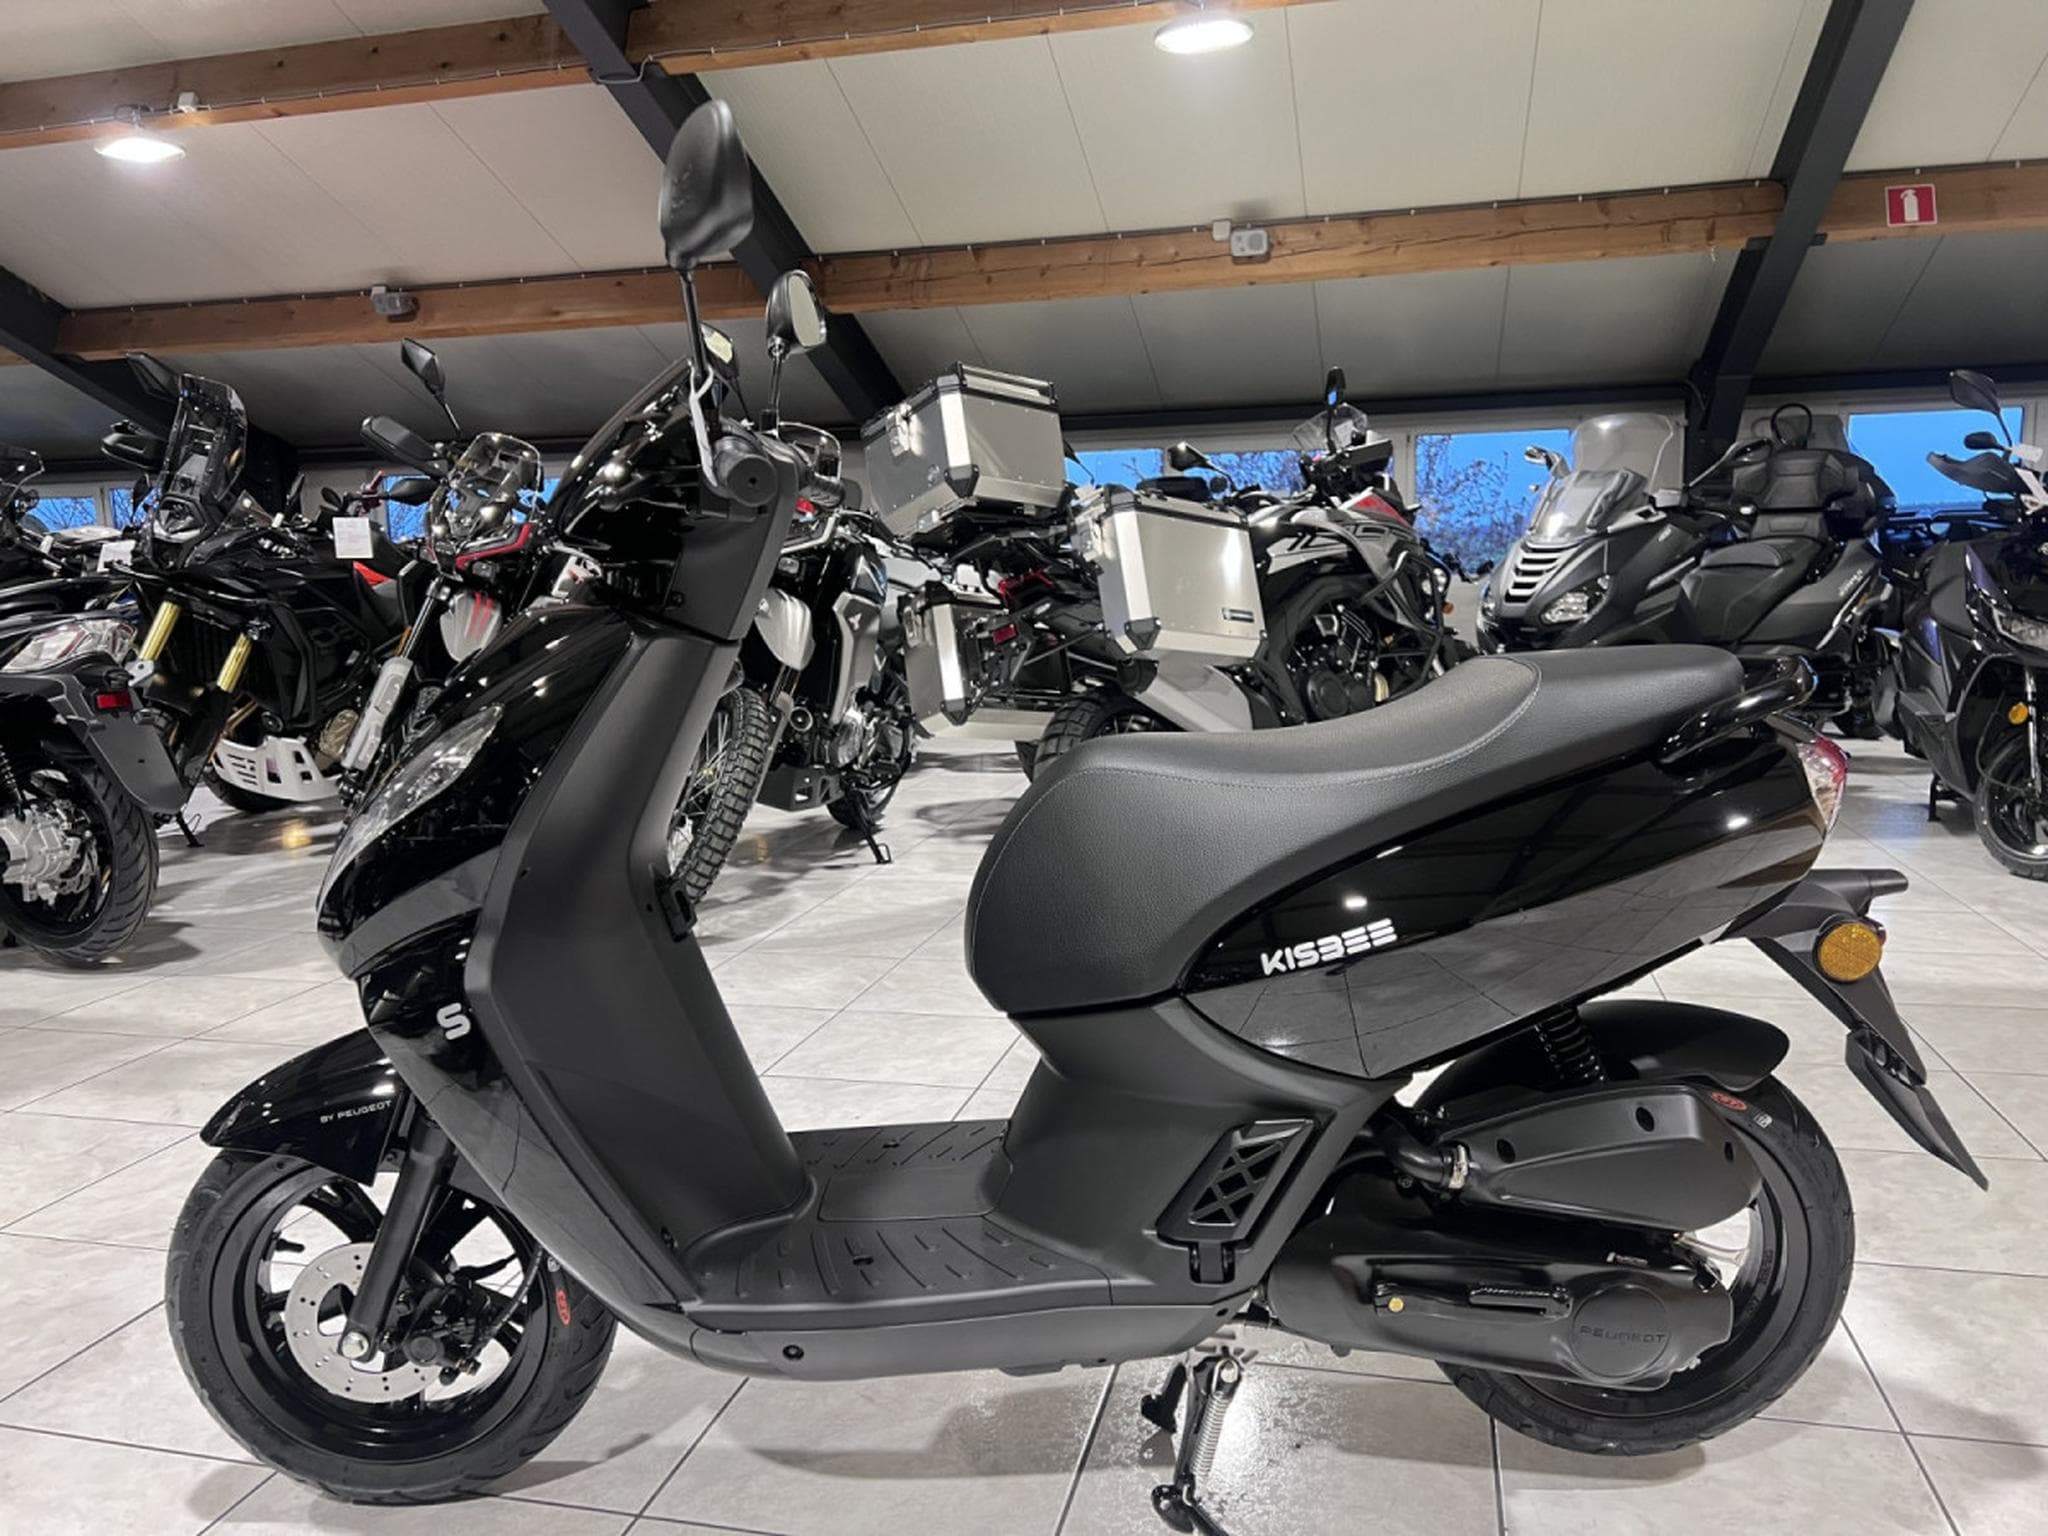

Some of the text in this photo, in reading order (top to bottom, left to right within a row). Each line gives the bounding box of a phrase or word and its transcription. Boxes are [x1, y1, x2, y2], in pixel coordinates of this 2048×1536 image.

[1260, 917, 1398, 976] KISBEE
[436, 1002, 471, 1040] S
[320, 1100, 393, 1124] BY PEUGEOT
